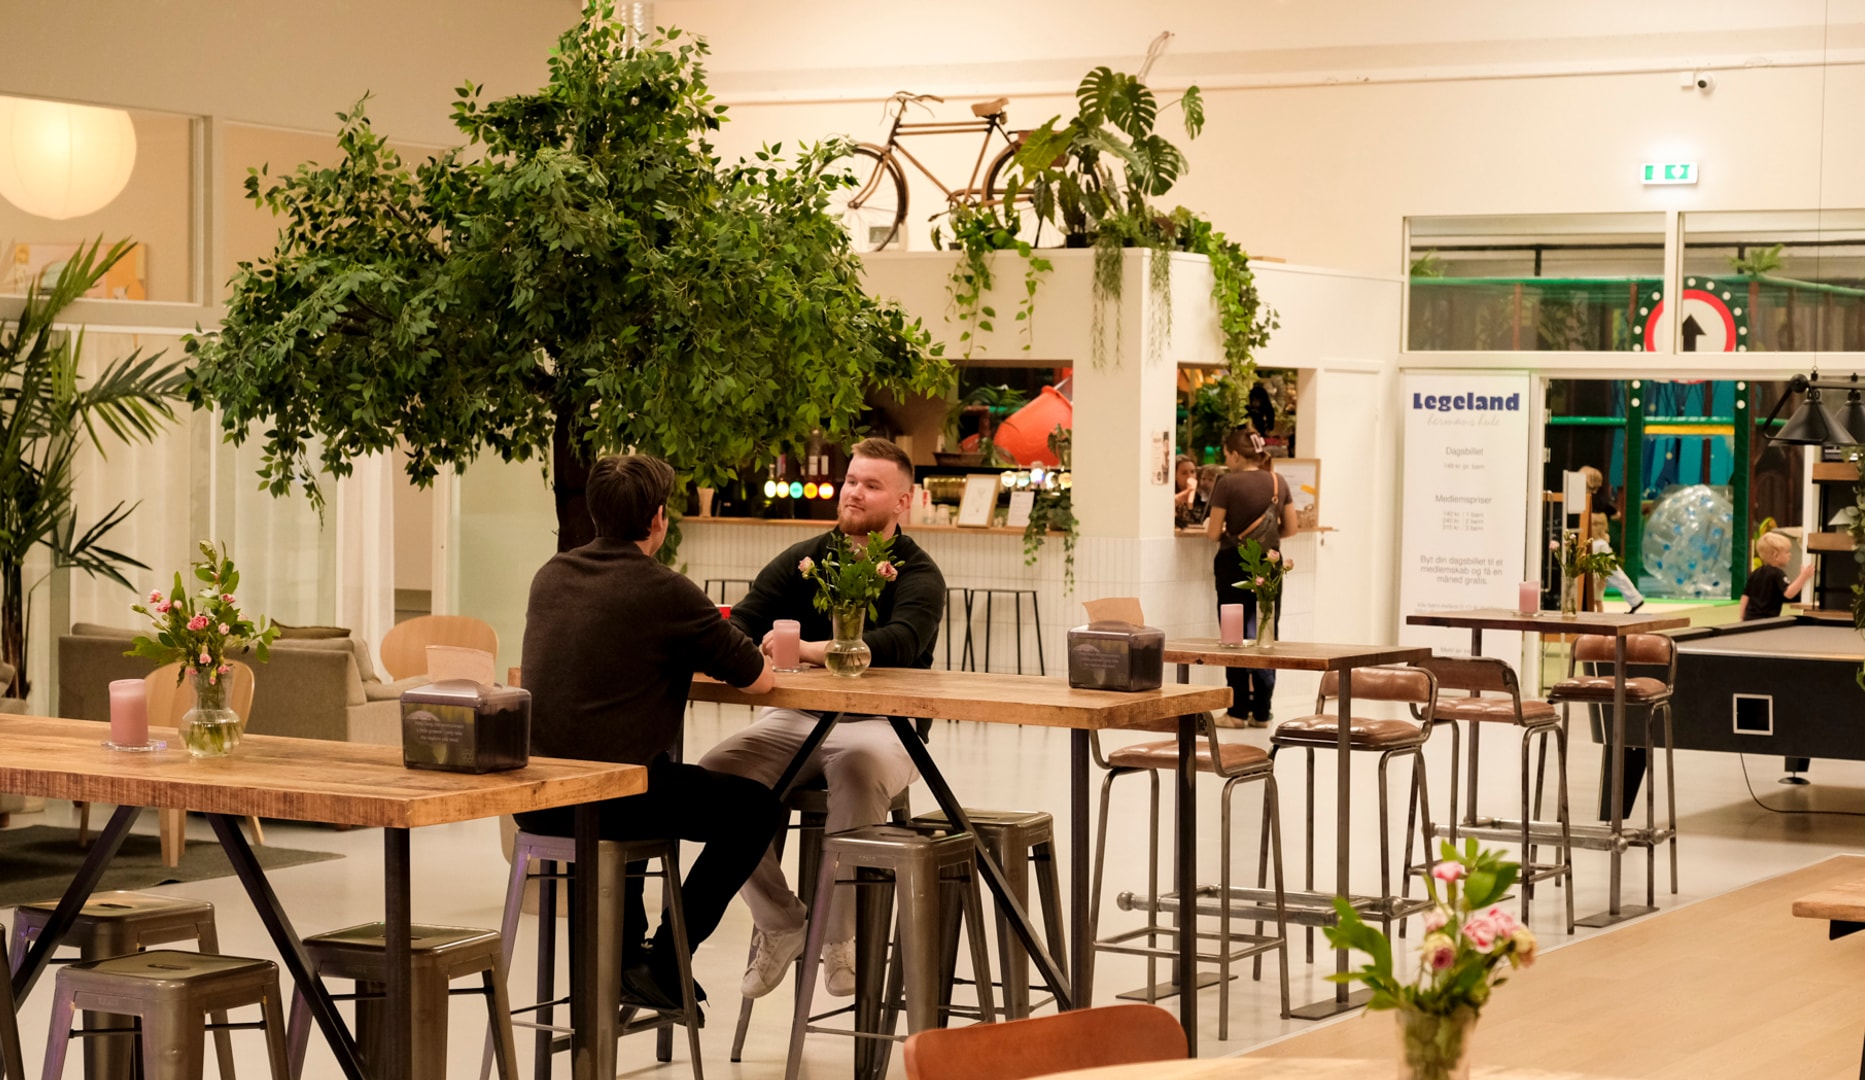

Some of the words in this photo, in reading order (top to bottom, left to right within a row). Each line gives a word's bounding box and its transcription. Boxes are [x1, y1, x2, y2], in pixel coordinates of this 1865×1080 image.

[1413, 392, 1520, 412] Legeland
[1445, 446, 1484, 457] Dagsbillet
[1435, 494, 1492, 504] Medlemspriser
[1420, 555, 1434, 565] Byt
[1435, 556, 1447, 564] din
[1448, 556, 1486, 566] dagsbillet
[1420, 566, 1470, 575] medlemskab
[1471, 568, 1482, 577] og
[1492, 568, 1504, 576] en
[1437, 575, 1463, 584] måned
